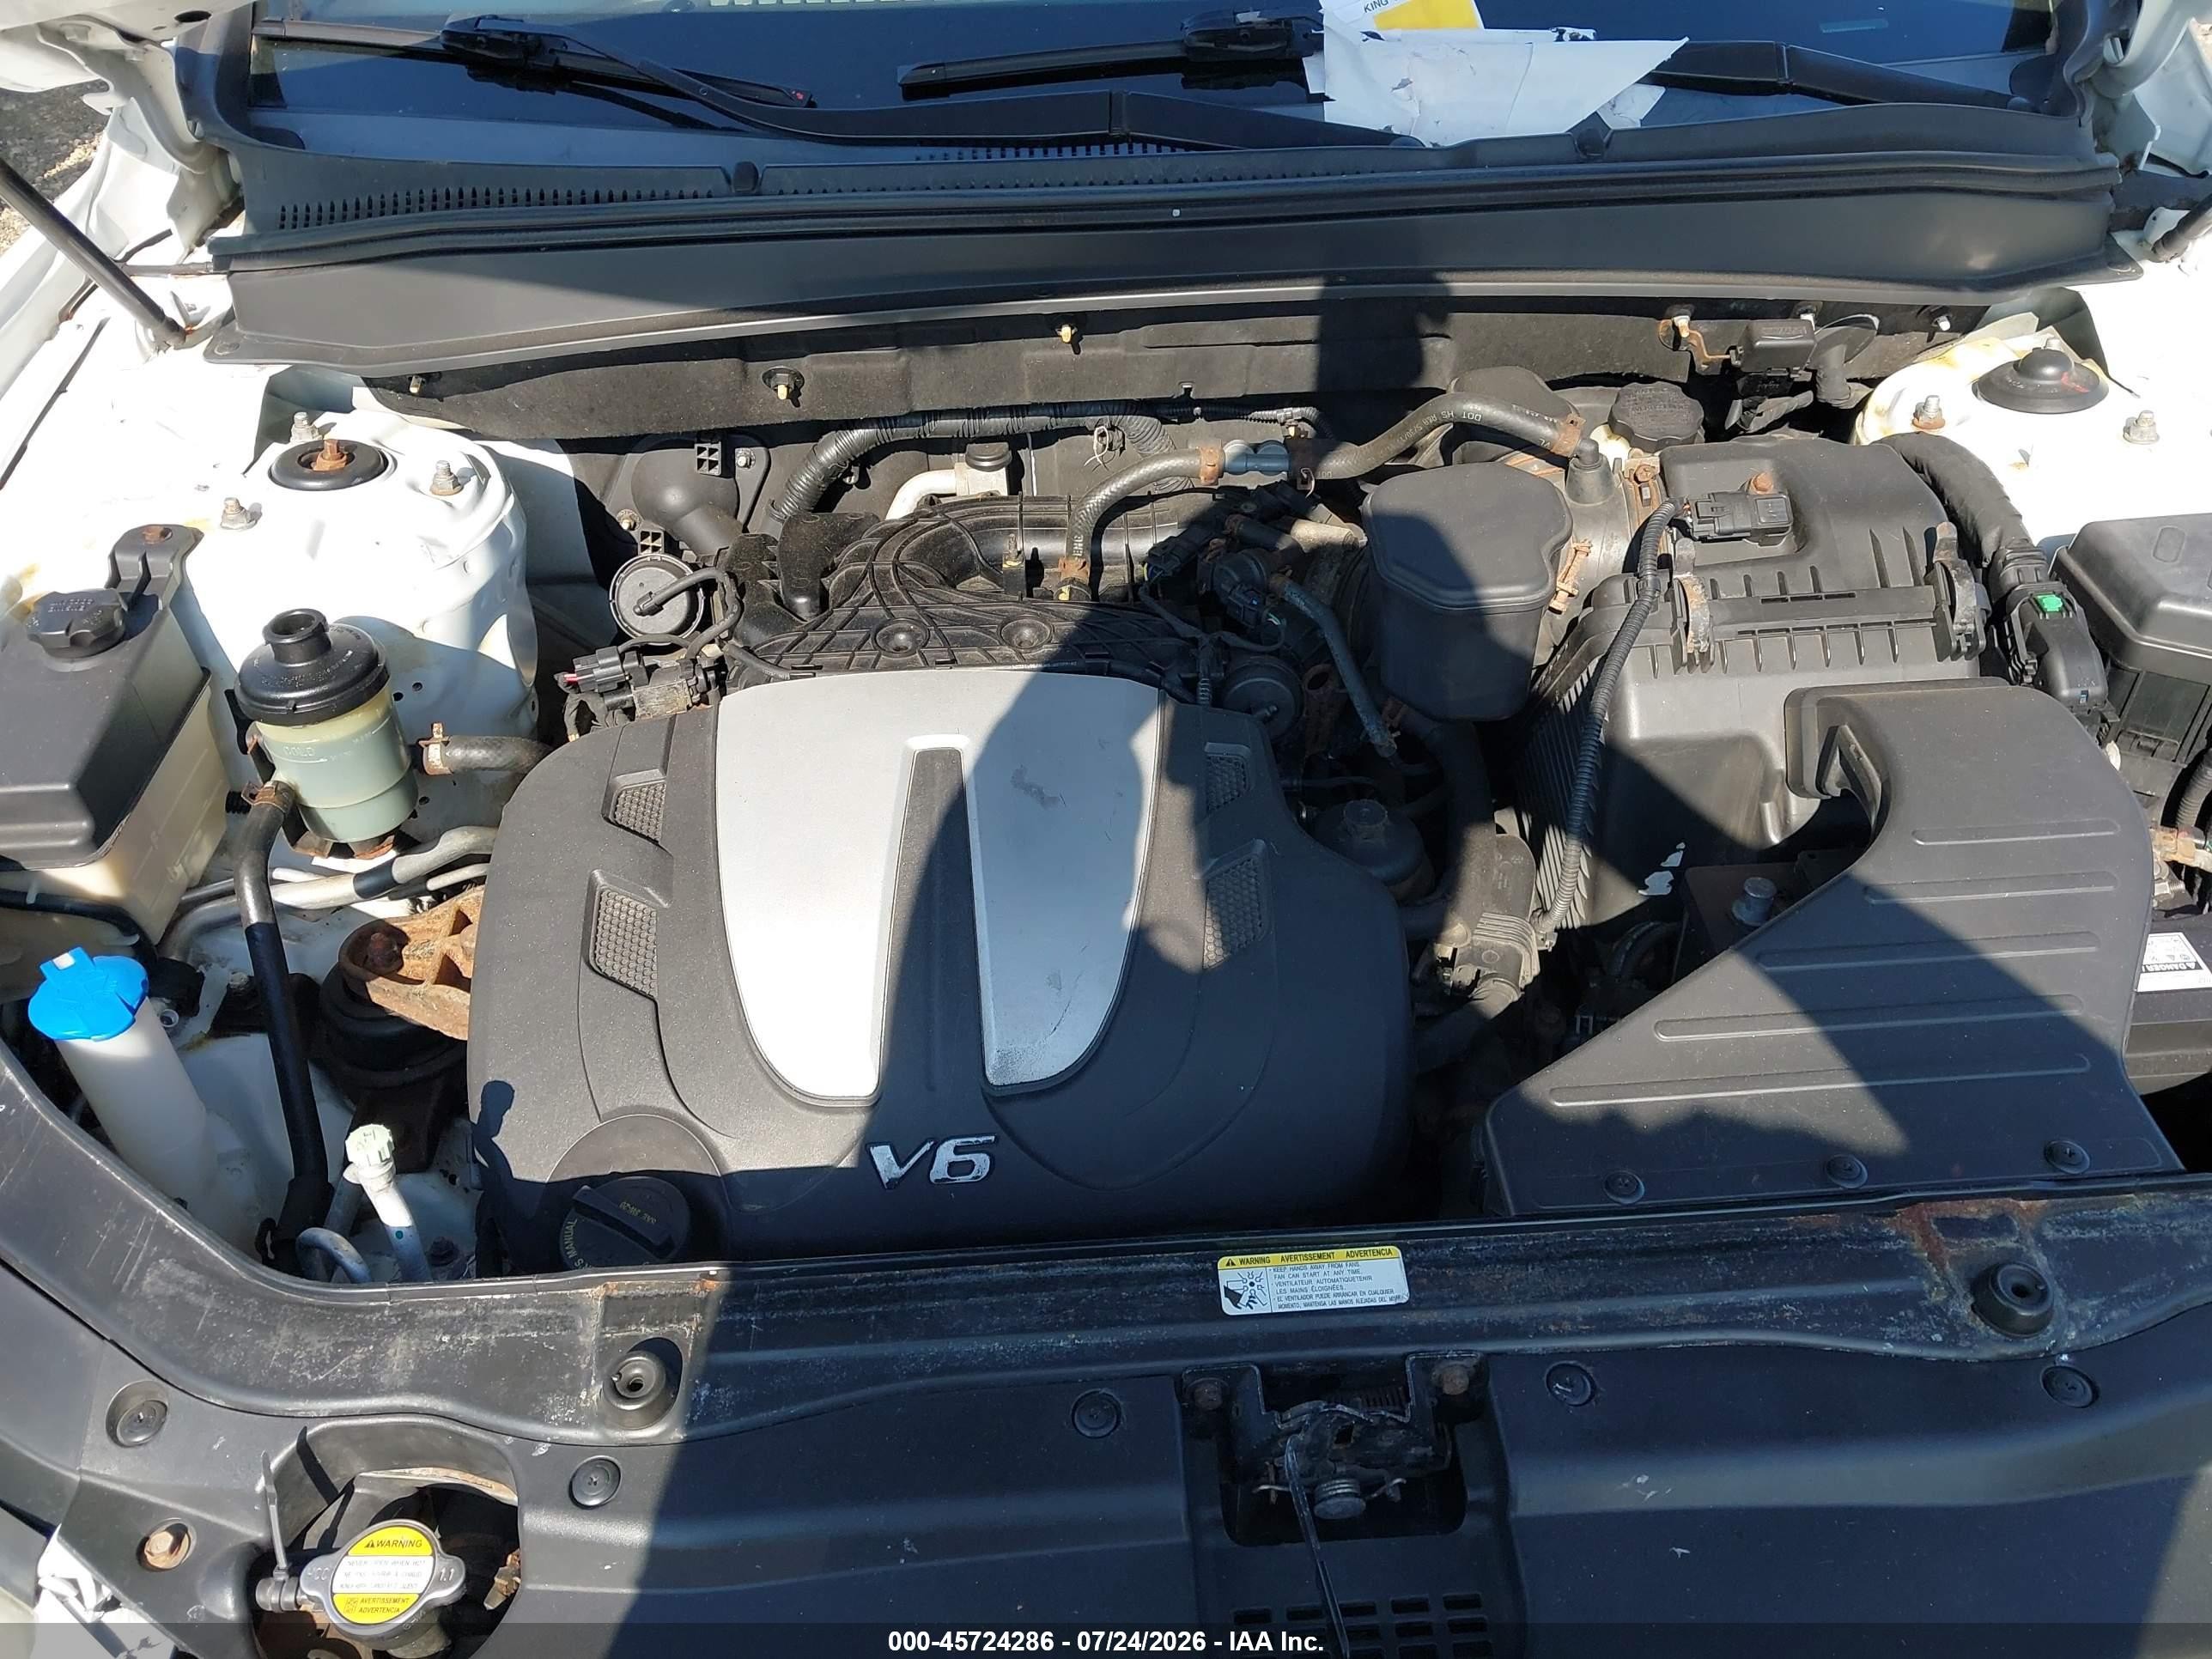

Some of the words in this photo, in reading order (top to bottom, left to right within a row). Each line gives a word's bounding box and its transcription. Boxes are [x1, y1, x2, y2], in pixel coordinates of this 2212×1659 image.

[1441, 410, 1455, 419] HS
[1462, 411, 1482, 422] DOT
[867, 1134, 997, 1189] V6
[563, 1218, 578, 1259] MANUAL
[1238, 1255, 1271, 1266] WARNING
[1280, 1252, 1335, 1263] AVERTISSEMENT
[1346, 1248, 1393, 1259] ADVERTENCIA
[375, 1539, 422, 1548] WARNING
[438, 1567, 456, 1582] 1.1
